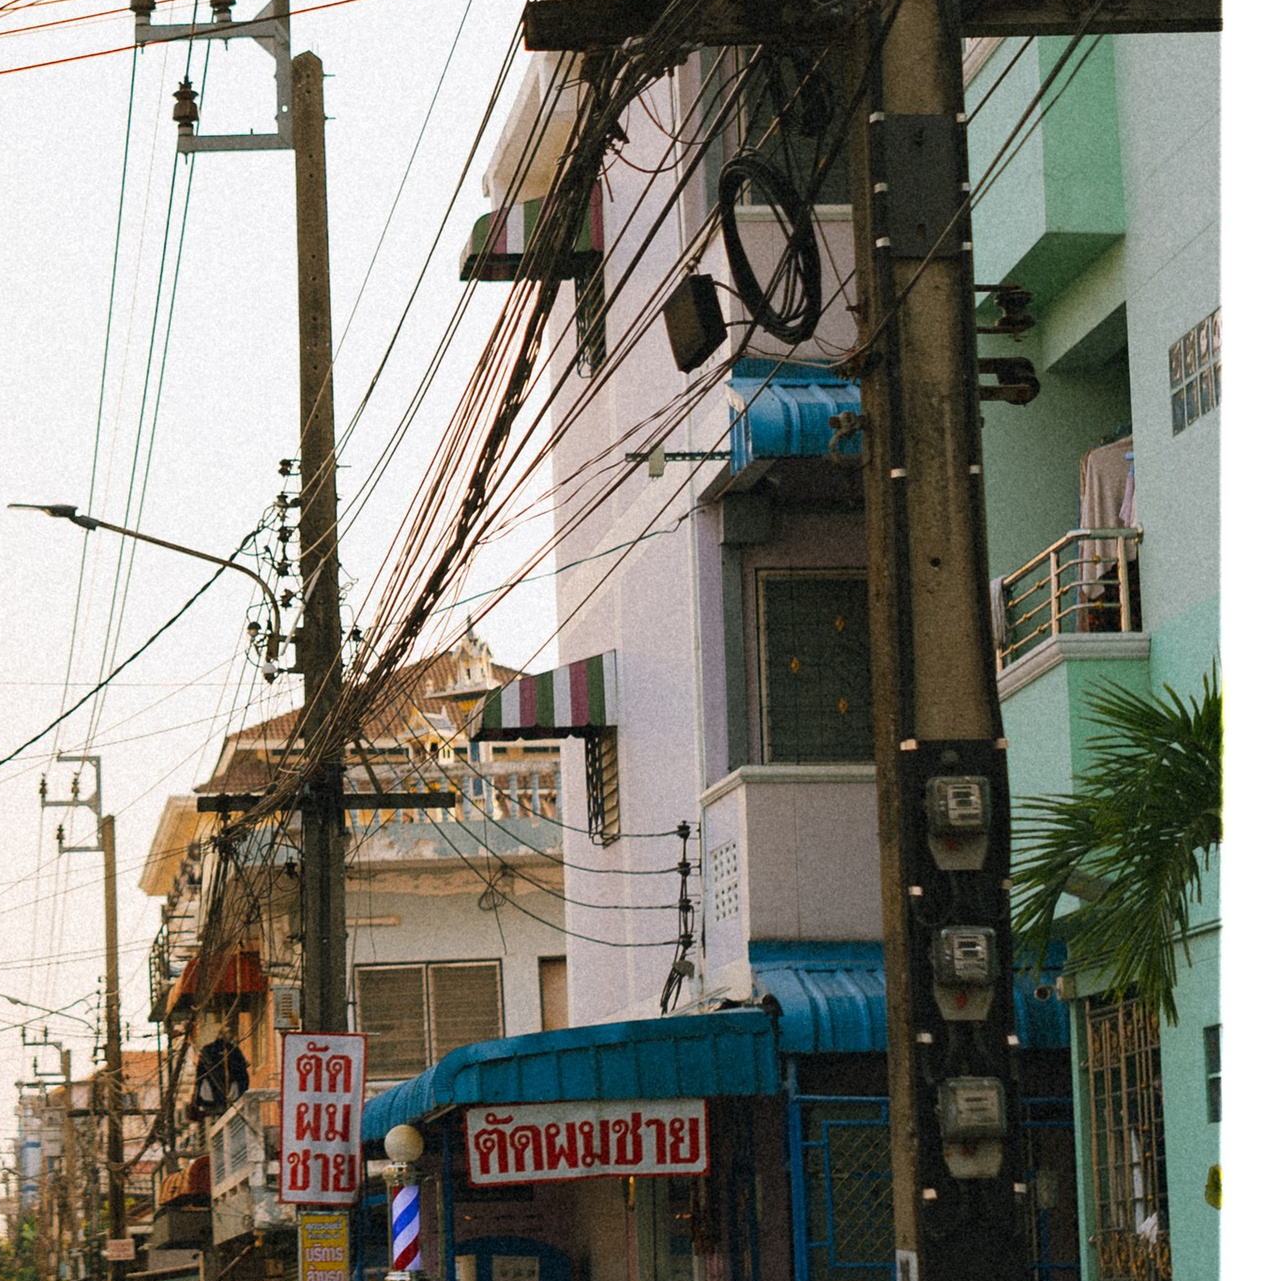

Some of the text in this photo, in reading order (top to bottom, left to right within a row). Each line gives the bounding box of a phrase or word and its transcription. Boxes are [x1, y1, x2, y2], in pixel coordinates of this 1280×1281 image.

[296, 1041, 352, 1093] ตัด
[296, 1102, 350, 1142] ผม
[473, 1112, 700, 1176] ตัดผมชาย
[287, 1150, 357, 1194] ชาย
[305, 1243, 344, 1262] บริการ
